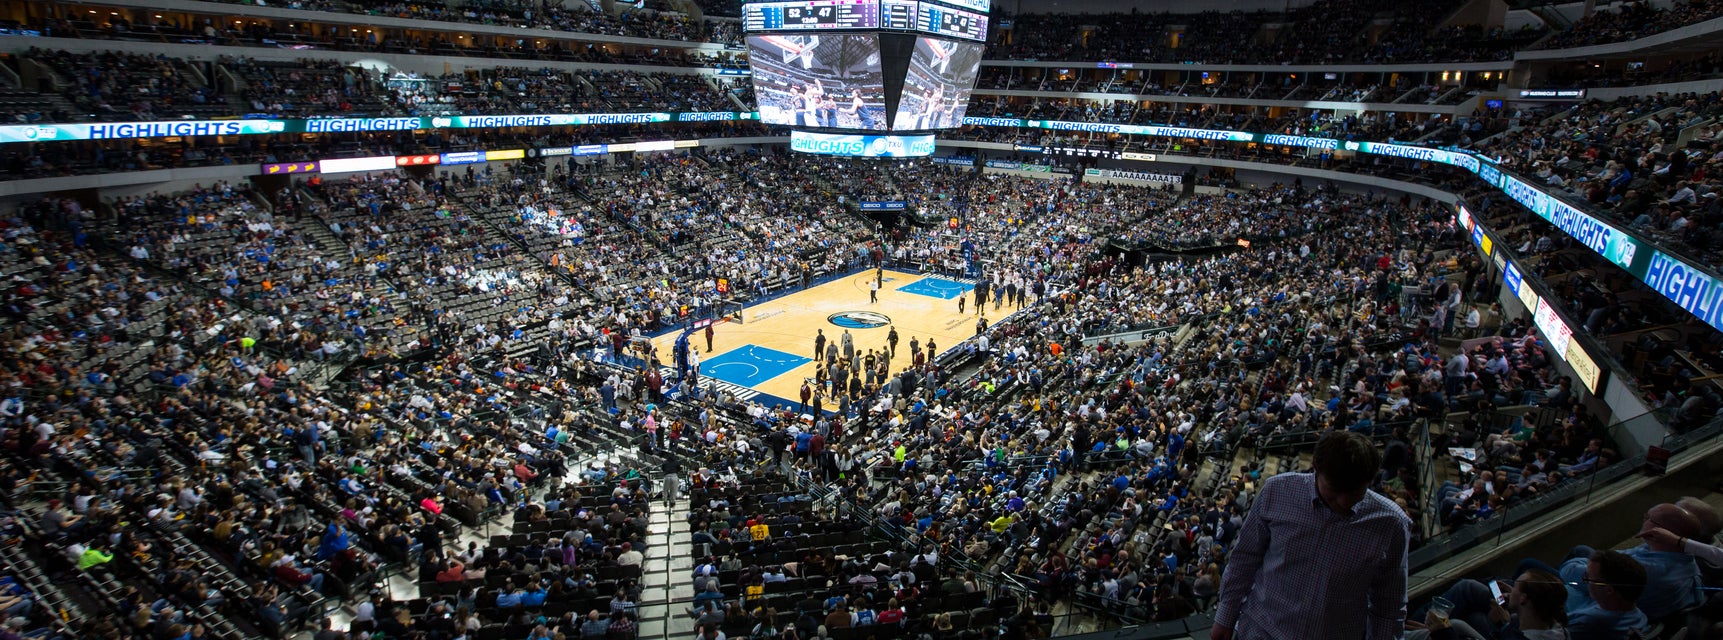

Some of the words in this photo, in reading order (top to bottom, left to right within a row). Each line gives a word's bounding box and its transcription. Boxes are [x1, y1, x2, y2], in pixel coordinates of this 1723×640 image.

[789, 8, 801, 18] 52
[819, 7, 832, 17] 47
[469, 116, 551, 128] HIGHLIGHTS
[588, 115, 651, 124] HIGHLIGHTS
[679, 112, 733, 122] HIGHLIGHTS
[962, 117, 1020, 127] IGHLIGHTS
[89, 122, 240, 139] HIGHLIGHTS
[306, 118, 421, 132] HIGHLIGHTS
[1051, 122, 1121, 133] HIGHLIGHTS
[1156, 128, 1229, 140] HIGHLIGHTS
[1264, 134, 1338, 149] HIGHLIGHTS
[1372, 144, 1435, 161] HIGHLIGHTS
[1553, 203, 1611, 255] HIGHLIGHTS
